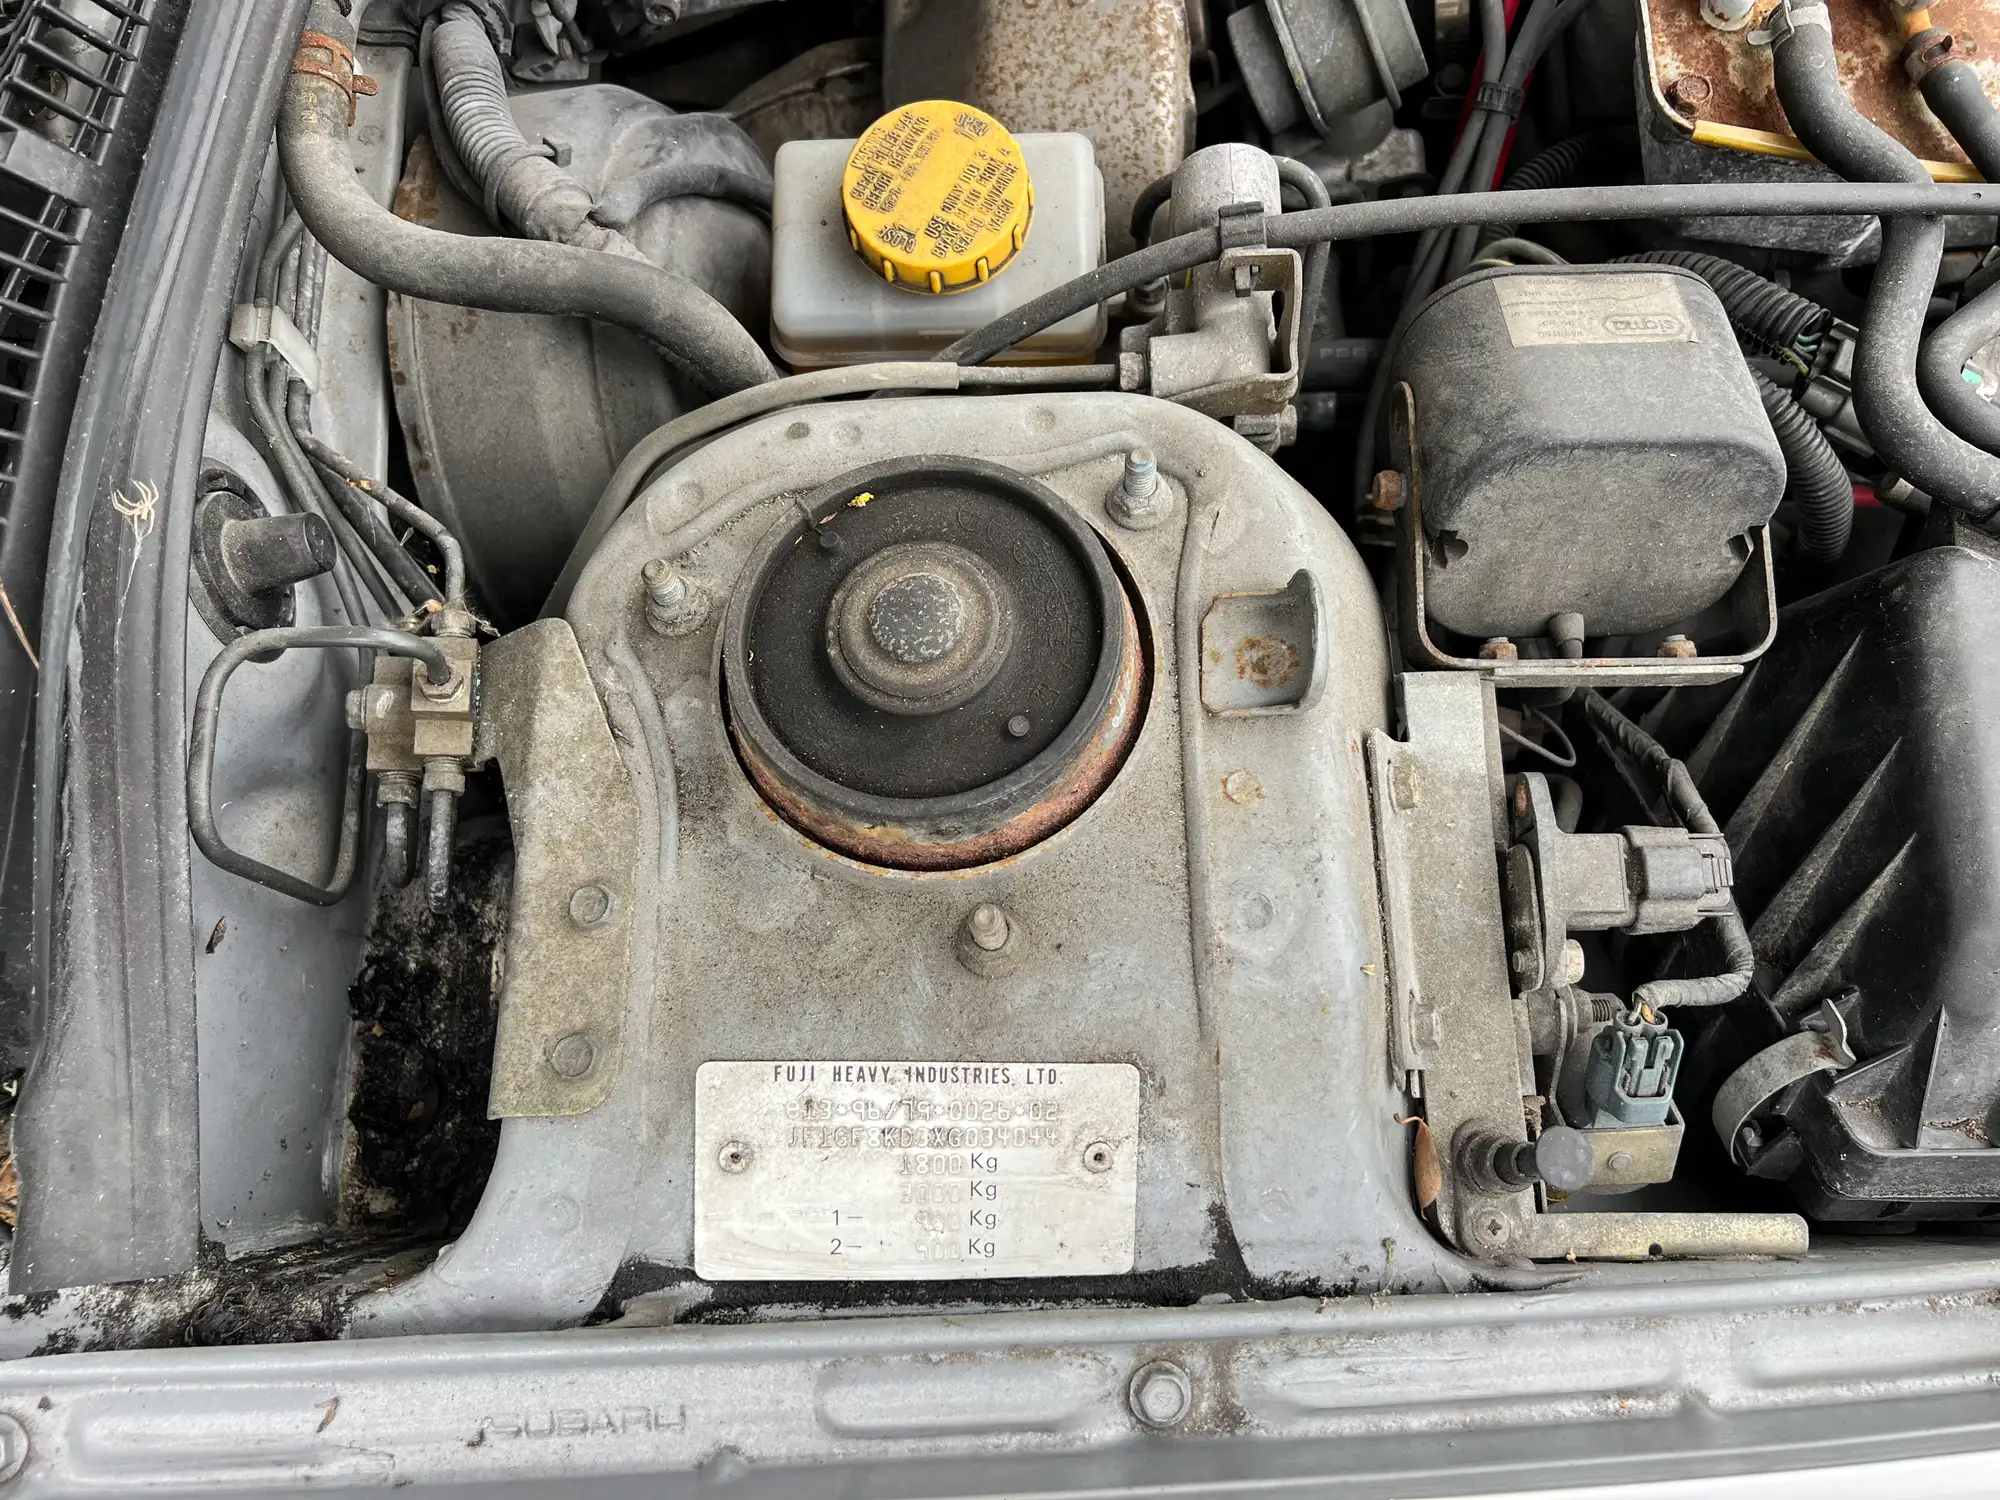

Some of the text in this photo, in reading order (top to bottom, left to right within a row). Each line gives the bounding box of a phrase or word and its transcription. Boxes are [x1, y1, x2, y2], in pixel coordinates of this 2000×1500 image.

[888, 116, 930, 169] REMOVING
[924, 215, 948, 239] USE
[941, 183, 967, 214] ONLY
[930, 219, 962, 259] BRAKE
[976, 156, 1005, 187] FROM
[952, 162, 1019, 255] SEALED CONTAINER
[877, 226, 917, 254] CLOSE
[774, 1065, 816, 1082] FUJI
[833, 1066, 891, 1083] HEAVY
[1026, 1067, 1064, 1085] LTD.
[787, 1125, 1058, 1148] JF1GF8KD3XG034044
[899, 1152, 998, 1176] 1800 Kg
[900, 1180, 997, 1204] 3000 Kg
[969, 1208, 997, 1230] Kg
[968, 1237, 996, 1259] Kg
